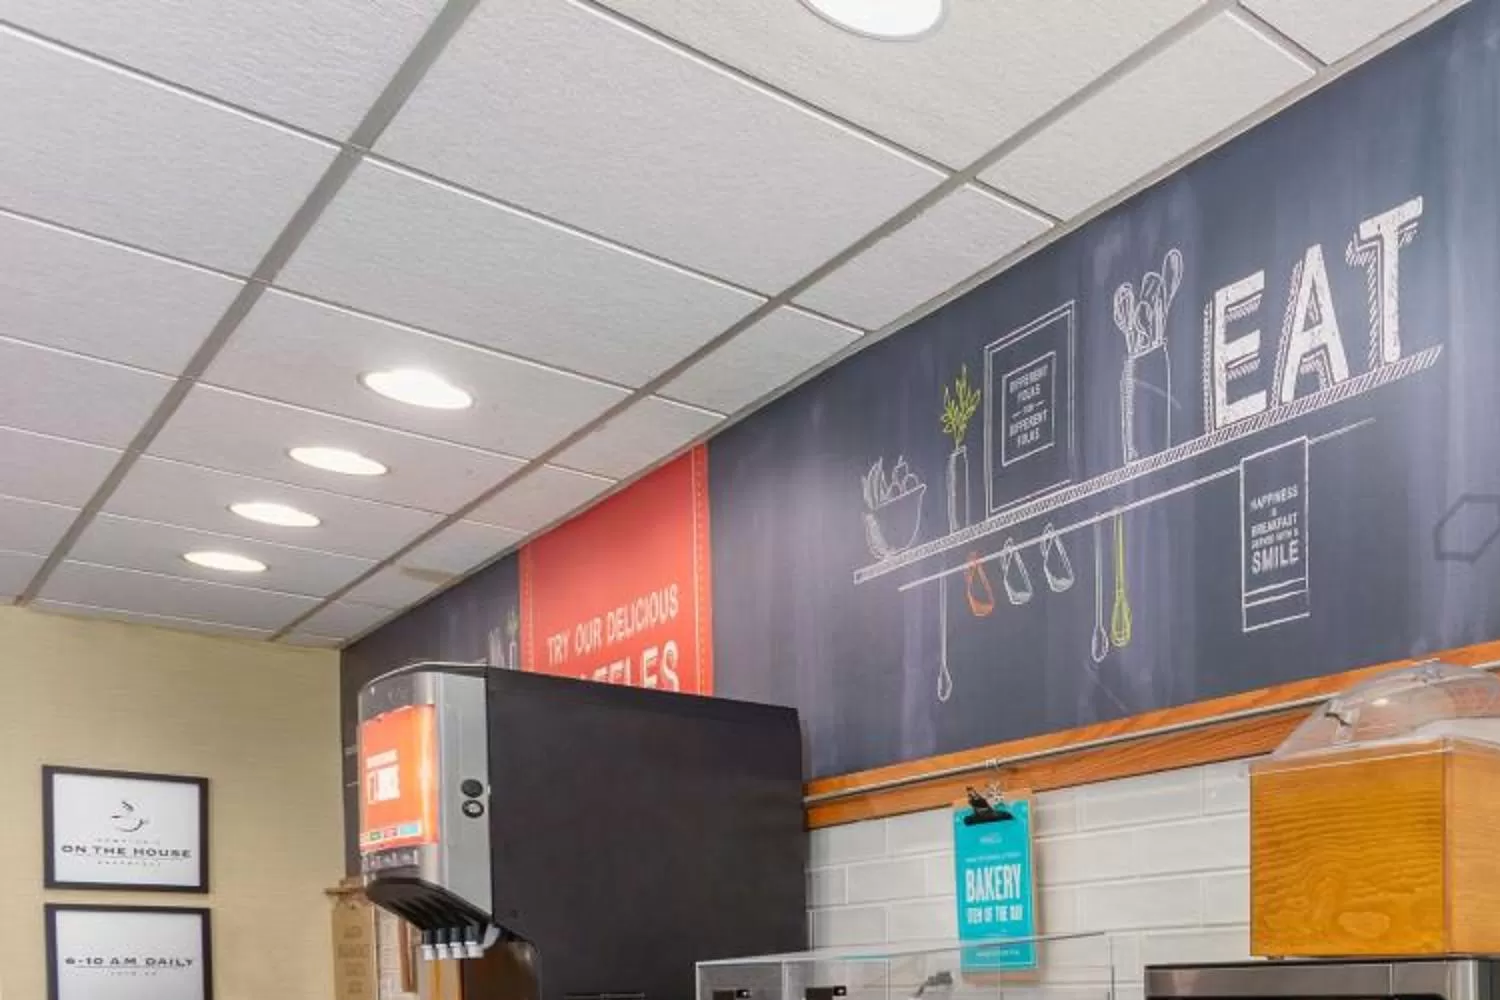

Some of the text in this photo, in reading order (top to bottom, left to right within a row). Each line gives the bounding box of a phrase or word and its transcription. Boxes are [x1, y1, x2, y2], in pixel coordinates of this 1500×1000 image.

[1205, 196, 1423, 430] EAT
[1251, 539, 1299, 574] SMILE
[548, 583, 679, 665] TRY OUR DELICIOUS
[61, 844, 193, 858] ON THE HOUSE
[965, 863, 1022, 904] BAKERY
[995, 905, 1009, 922] THE
[110, 957, 137, 965] AM
[145, 957, 193, 968] DAILY
